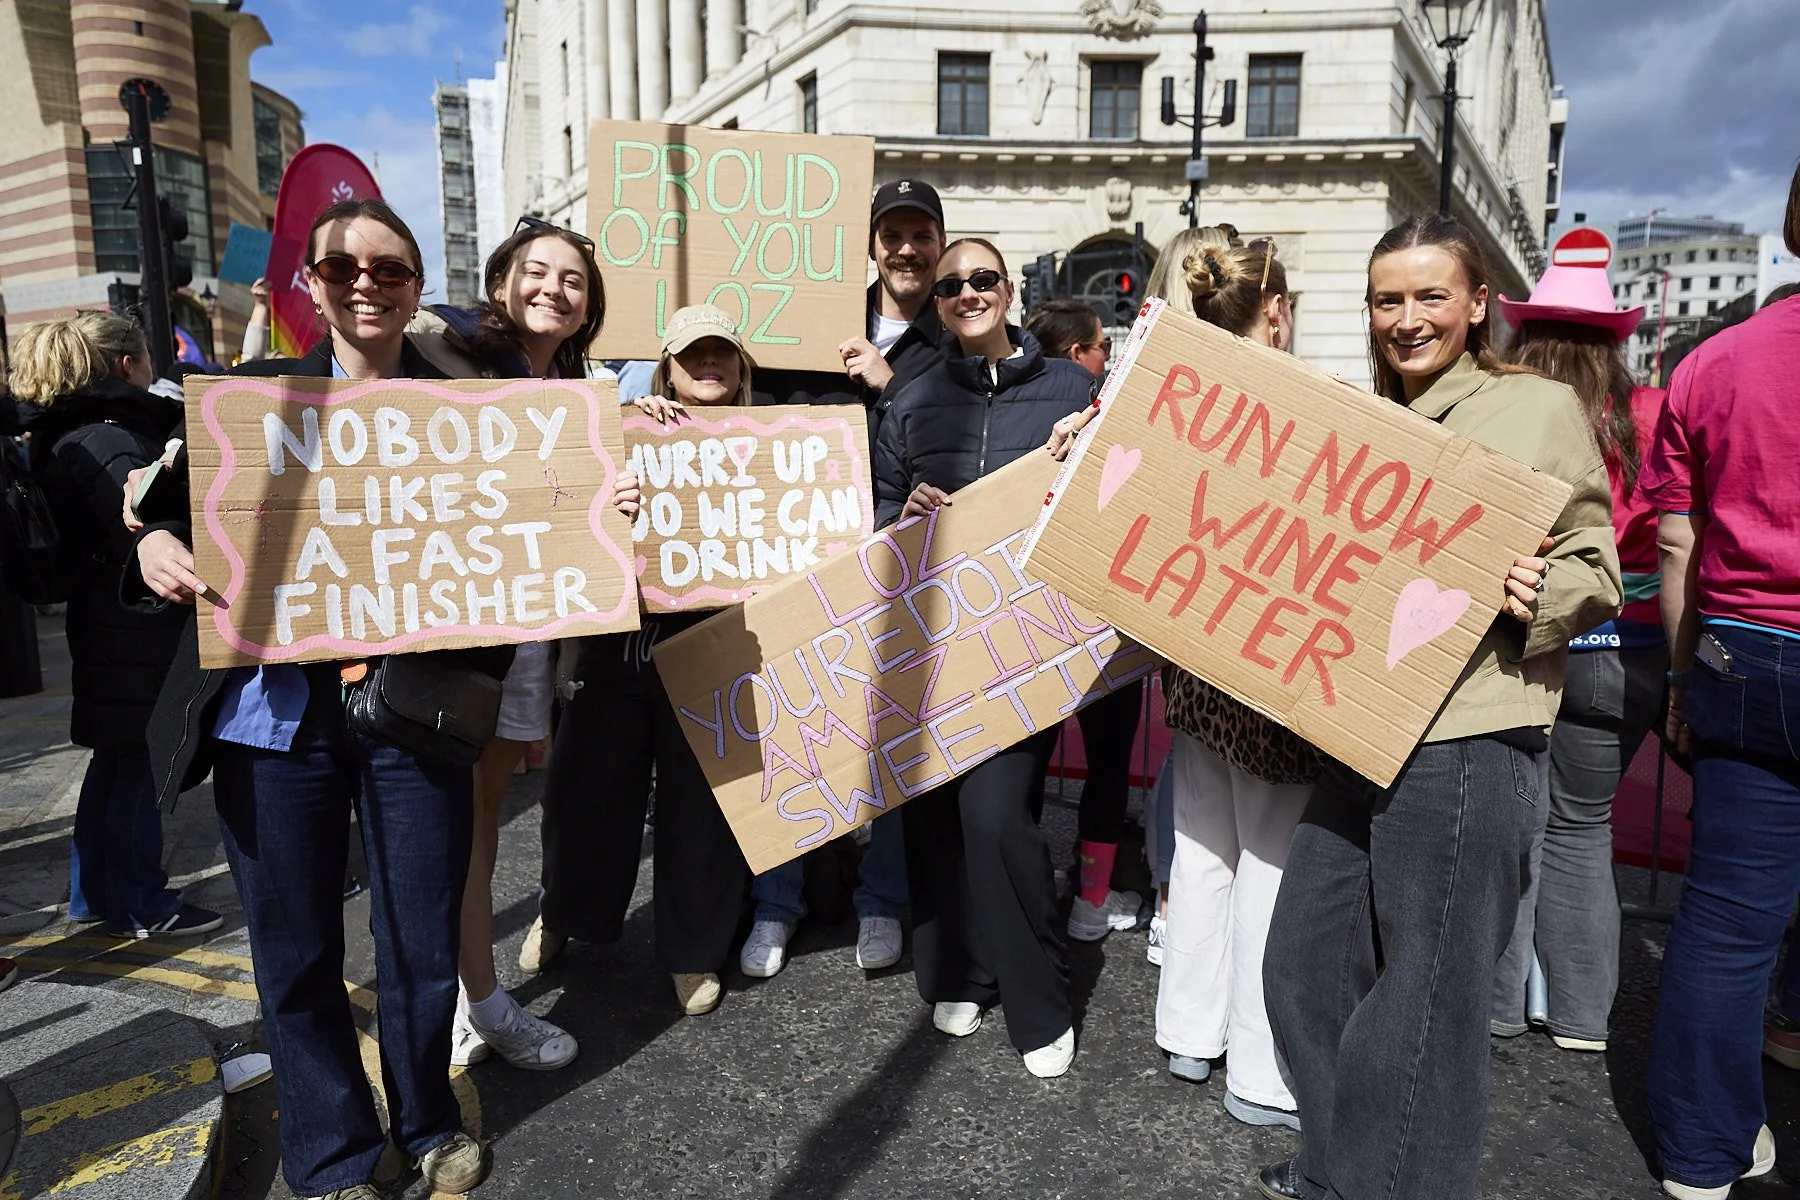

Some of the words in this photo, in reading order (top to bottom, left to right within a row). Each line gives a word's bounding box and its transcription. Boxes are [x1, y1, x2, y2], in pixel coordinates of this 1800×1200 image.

[613, 140, 840, 219] PROUD
[722, 217, 844, 282] YOU
[655, 279, 801, 344] LOZ
[262, 406, 567, 475] NOBODY
[772, 435, 829, 484] UP
[1147, 364, 1296, 478] RUN
[1292, 430, 1485, 567] NOW
[317, 469, 510, 526] LIKES
[697, 488, 766, 538] WE
[776, 485, 862, 537] CAN
[295, 526, 349, 580] A
[371, 521, 552, 585] FAST
[659, 535, 822, 587] DRINK
[807, 506, 968, 627] LOZ
[1189, 470, 1383, 617] WINE
[273, 567, 598, 646] FINISHER
[901, 529, 1048, 645] DOI
[1108, 514, 1355, 707] LATER
[1568, 634, 1621, 647] s.org
